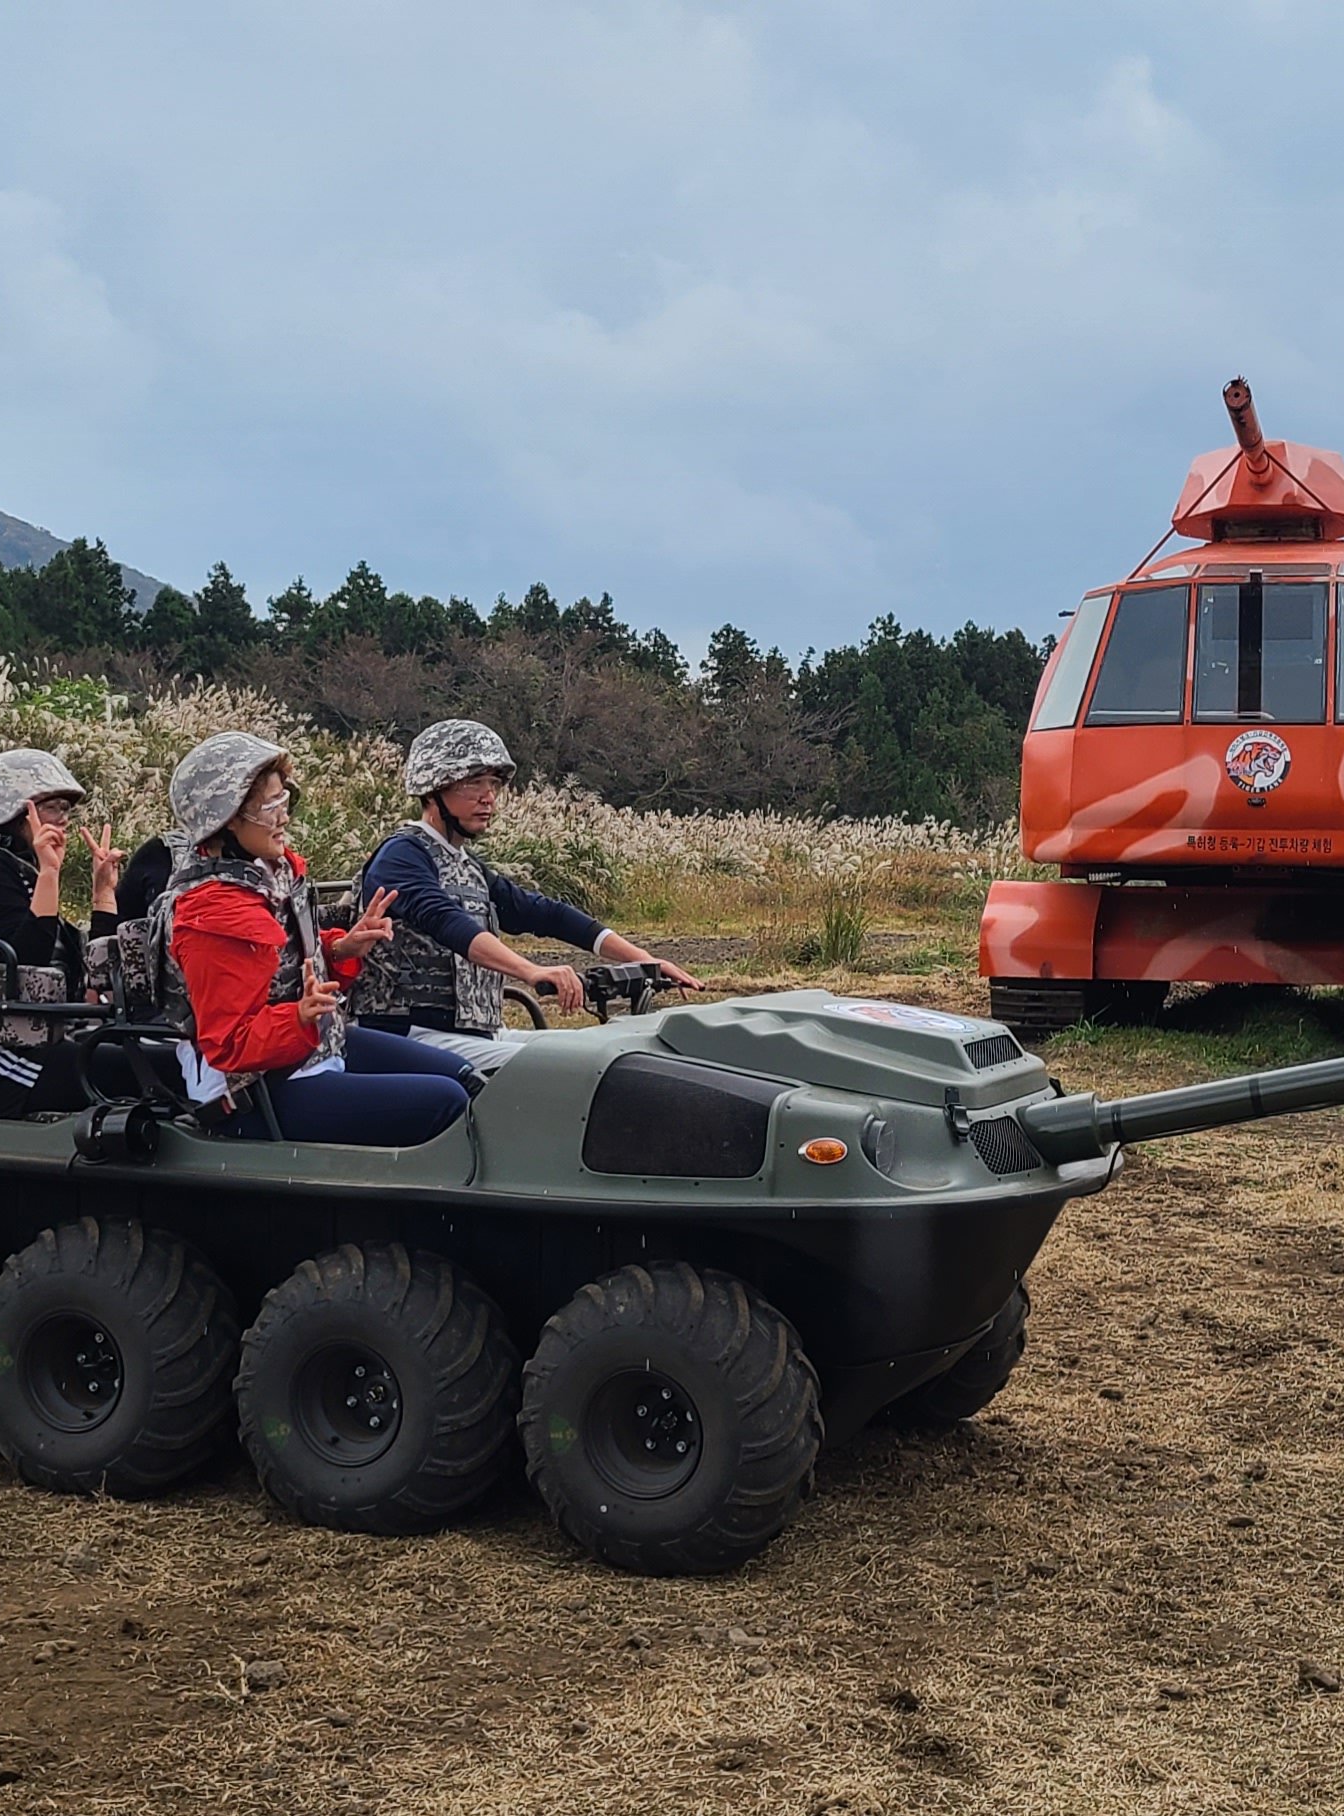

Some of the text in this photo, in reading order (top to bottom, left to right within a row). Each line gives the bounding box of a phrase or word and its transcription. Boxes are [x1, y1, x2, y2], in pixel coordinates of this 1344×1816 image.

[1237, 780, 1261, 793] TIGER
[1269, 837, 1309, 853] 전투차량
[1312, 838, 1332, 853] 체험
